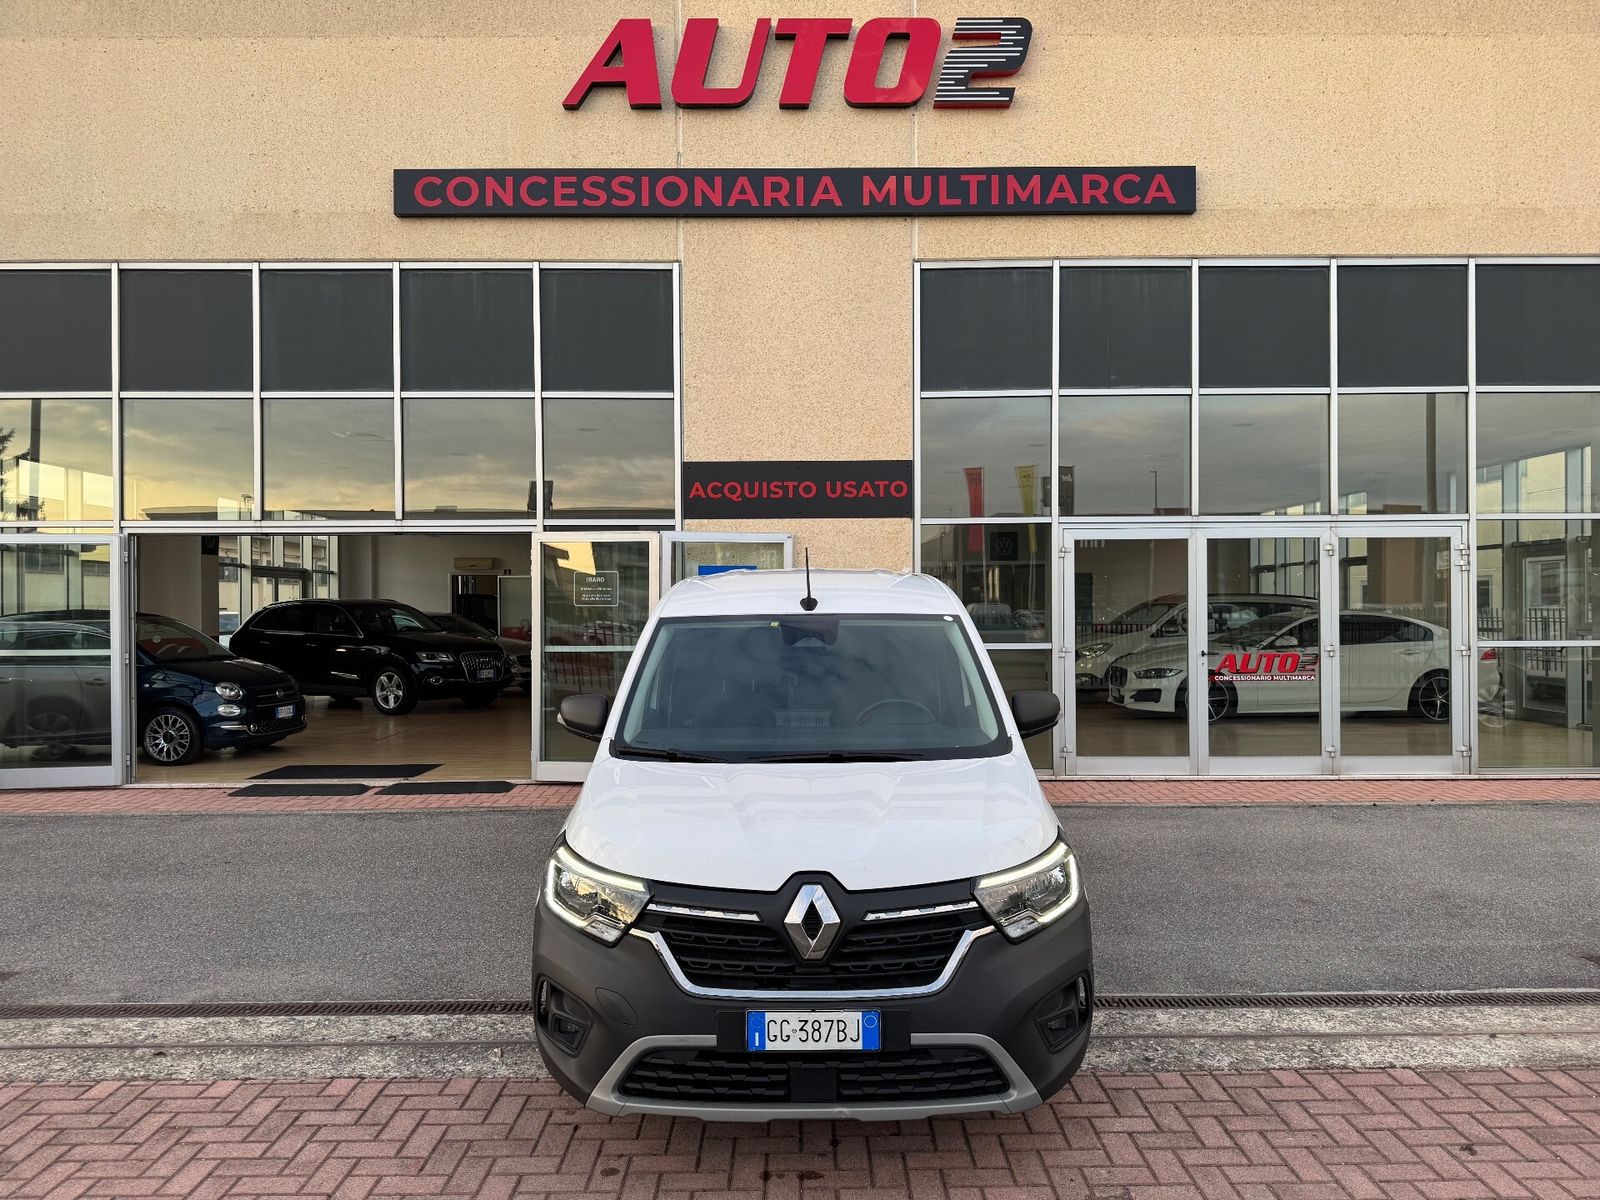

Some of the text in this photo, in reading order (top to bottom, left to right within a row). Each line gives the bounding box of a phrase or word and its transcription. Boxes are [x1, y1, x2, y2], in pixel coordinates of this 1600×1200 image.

[561, 16, 1033, 109] AUTO2
[413, 173, 1177, 207] CONCESSIONARIA MULTIMARCA
[688, 480, 908, 501] ACQUISTO USATO
[1215, 652, 1319, 673] AUTO2
